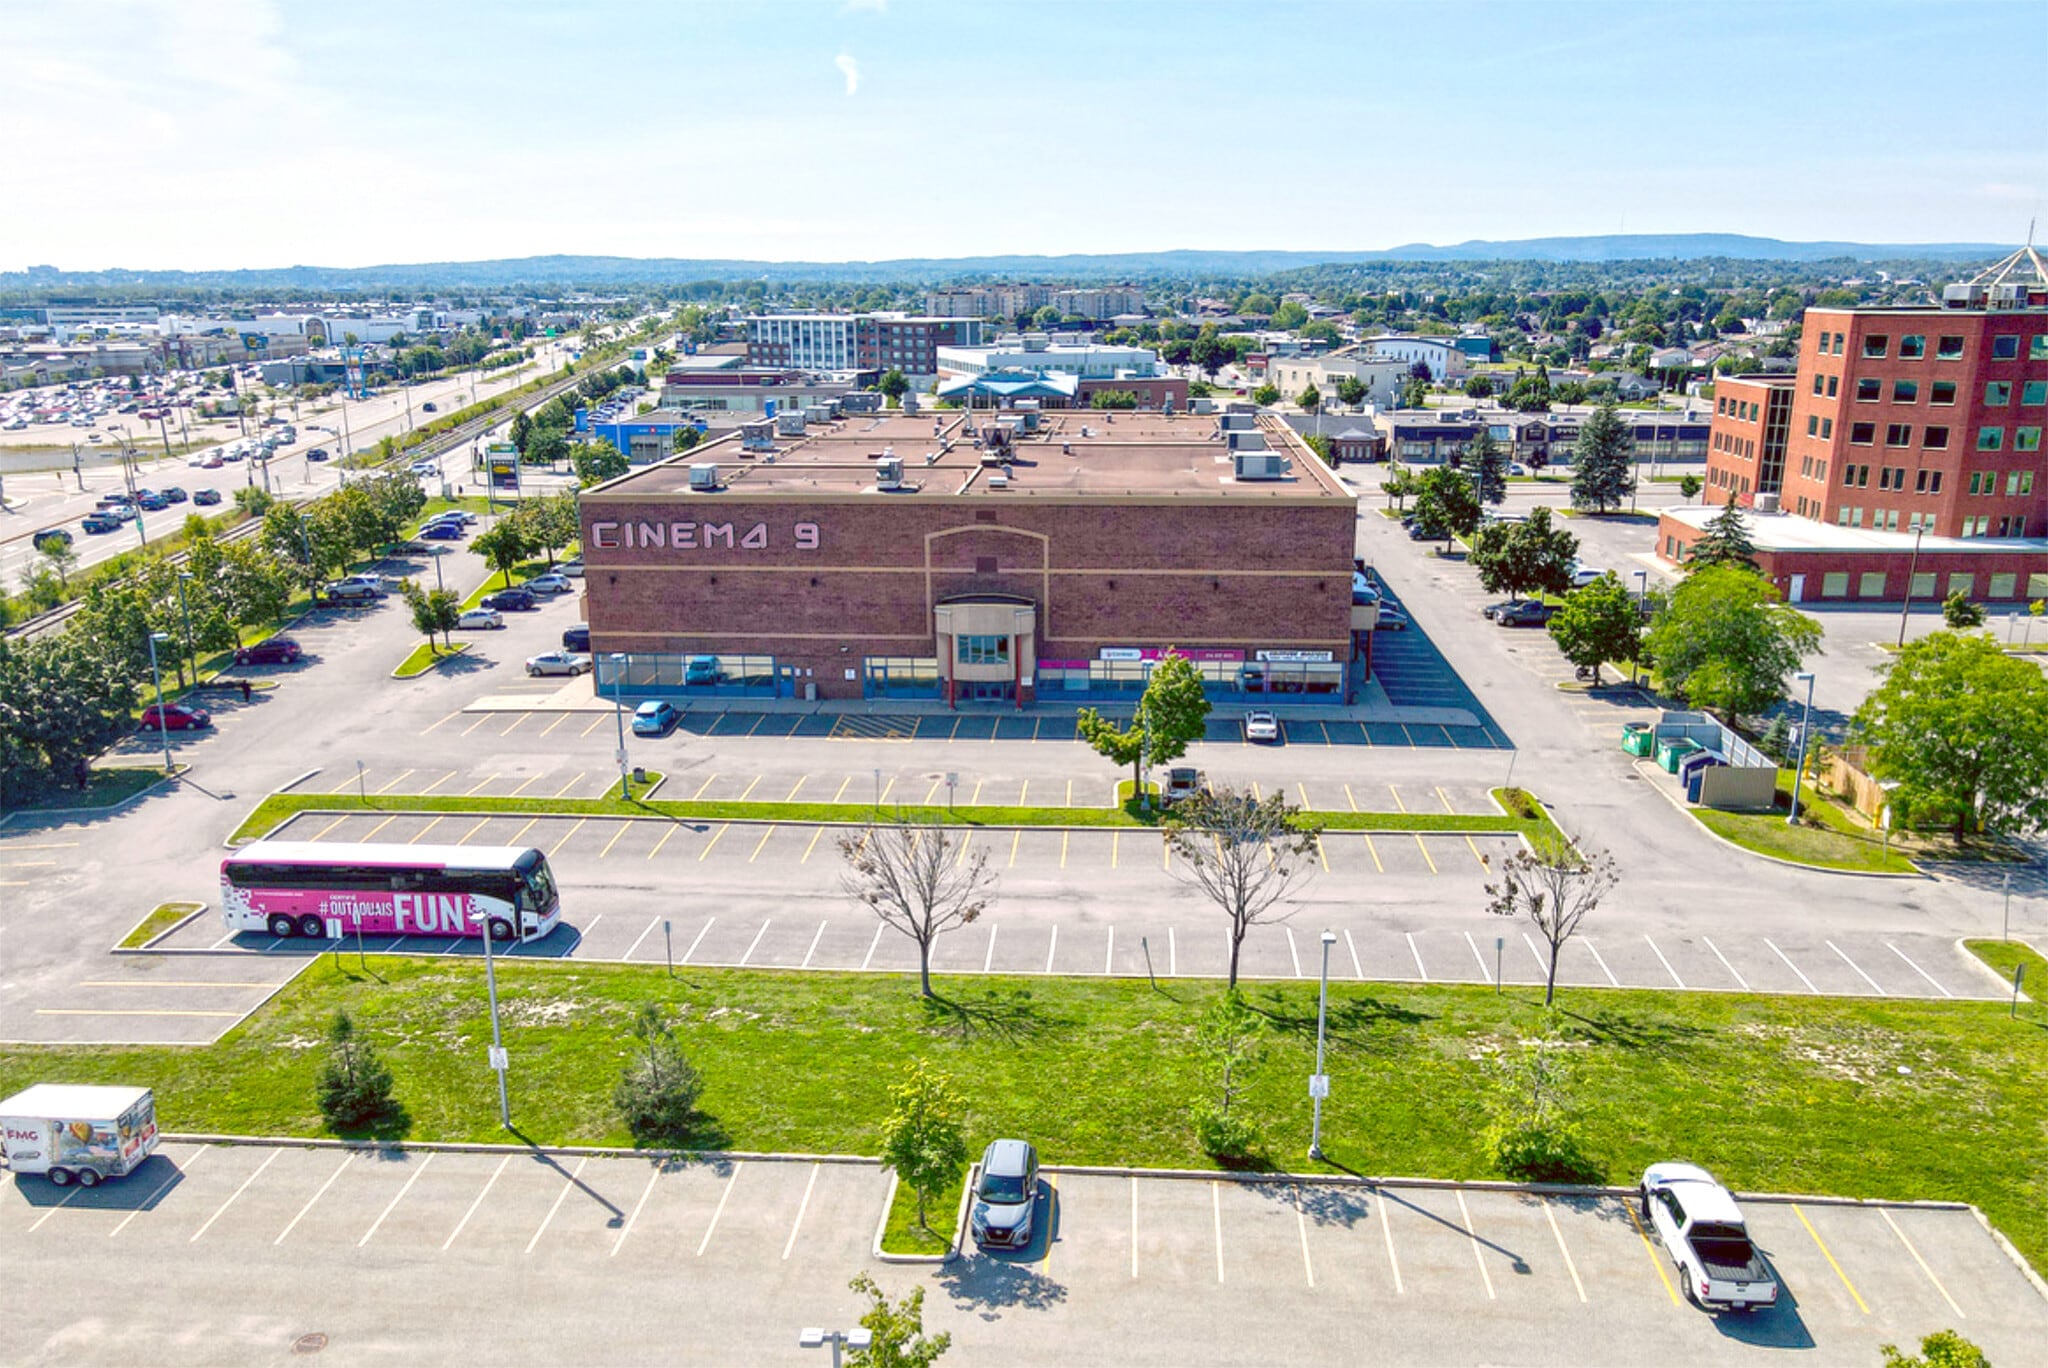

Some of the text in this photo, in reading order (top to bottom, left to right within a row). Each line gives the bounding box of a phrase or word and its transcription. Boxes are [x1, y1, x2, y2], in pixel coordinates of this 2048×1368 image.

[591, 522, 820, 549] CINEMA 9
[393, 894, 464, 931] FUN
[7, 1130, 38, 1141] FMG
